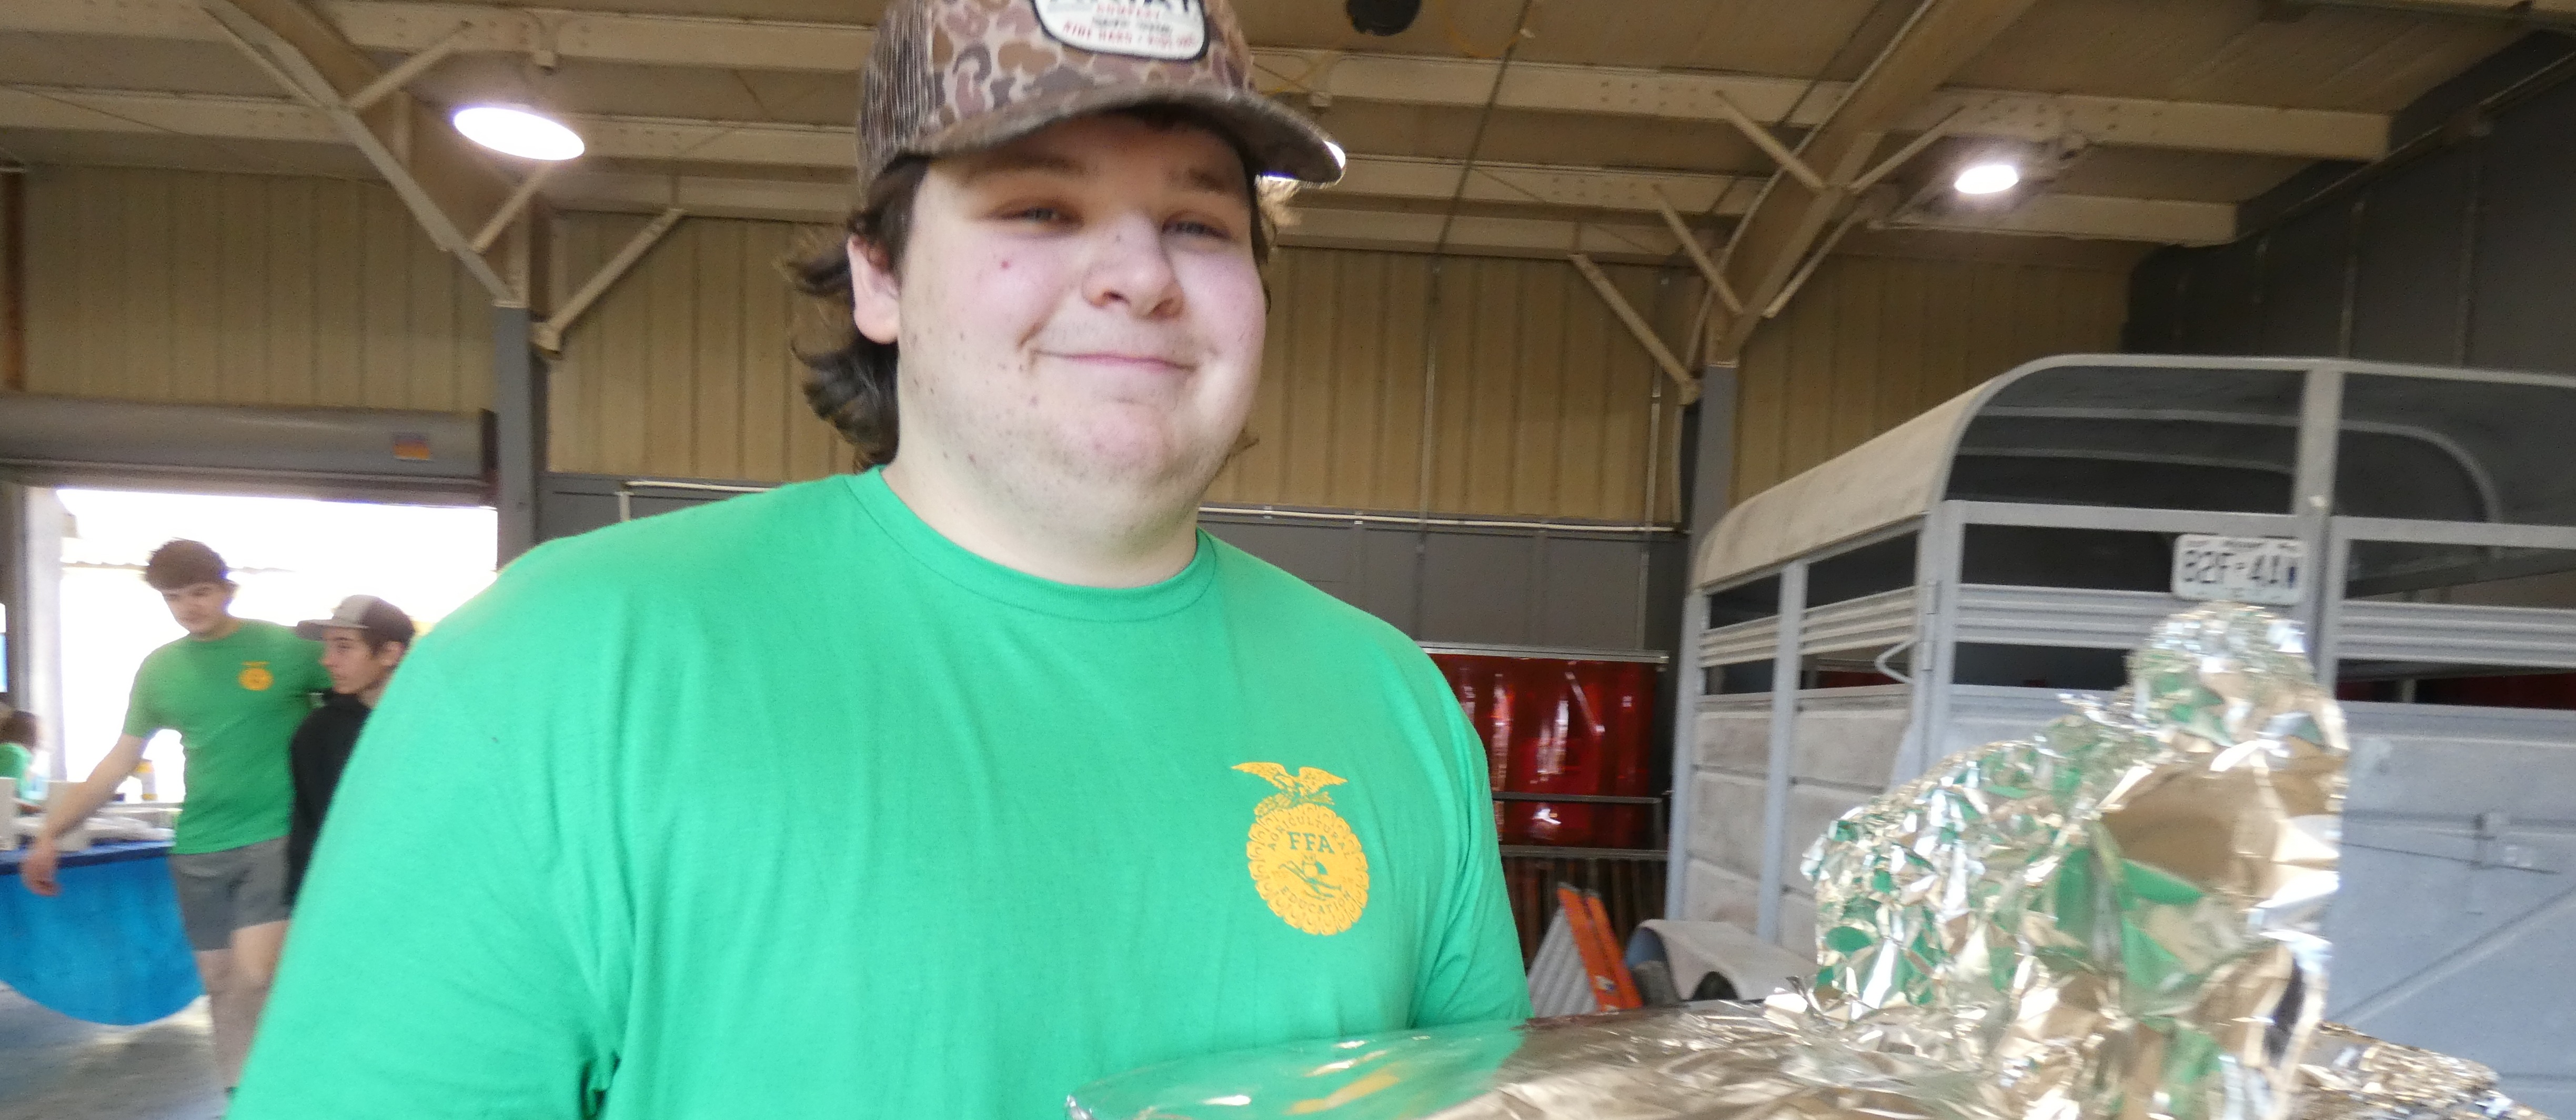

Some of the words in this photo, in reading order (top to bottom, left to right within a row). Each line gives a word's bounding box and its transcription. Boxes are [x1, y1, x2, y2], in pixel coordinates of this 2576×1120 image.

[1269, 815, 1355, 859] AGRICULTURAL
[1288, 831, 1335, 855] FFA
[1281, 885, 1352, 914] EDUCATION
